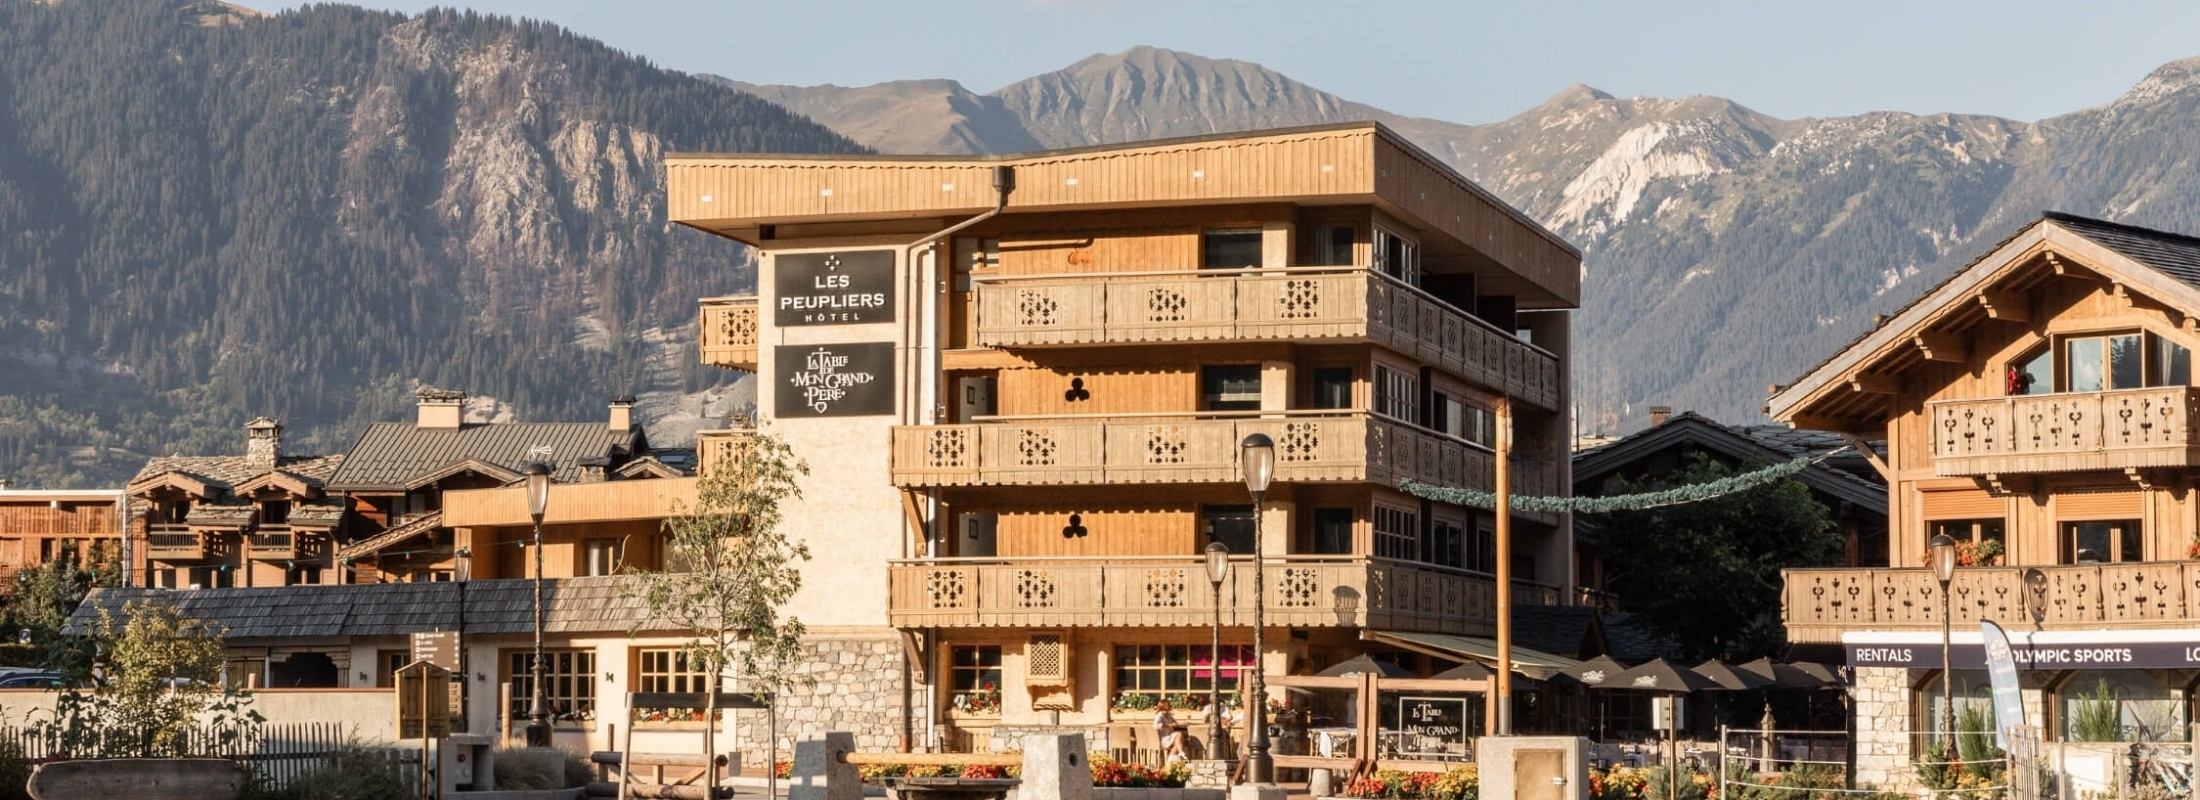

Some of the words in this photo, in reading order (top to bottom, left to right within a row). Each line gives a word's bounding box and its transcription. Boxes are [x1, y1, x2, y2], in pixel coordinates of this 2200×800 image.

[815, 275, 850, 289] LES
[780, 293, 885, 310] PEUPLIERS
[805, 312, 860, 322] HÔTEL
[795, 371, 825, 387] MON
[825, 372, 870, 389] GRAND
[1856, 648, 1912, 662] RENTALS
[2074, 648, 2133, 662] SPORTS
